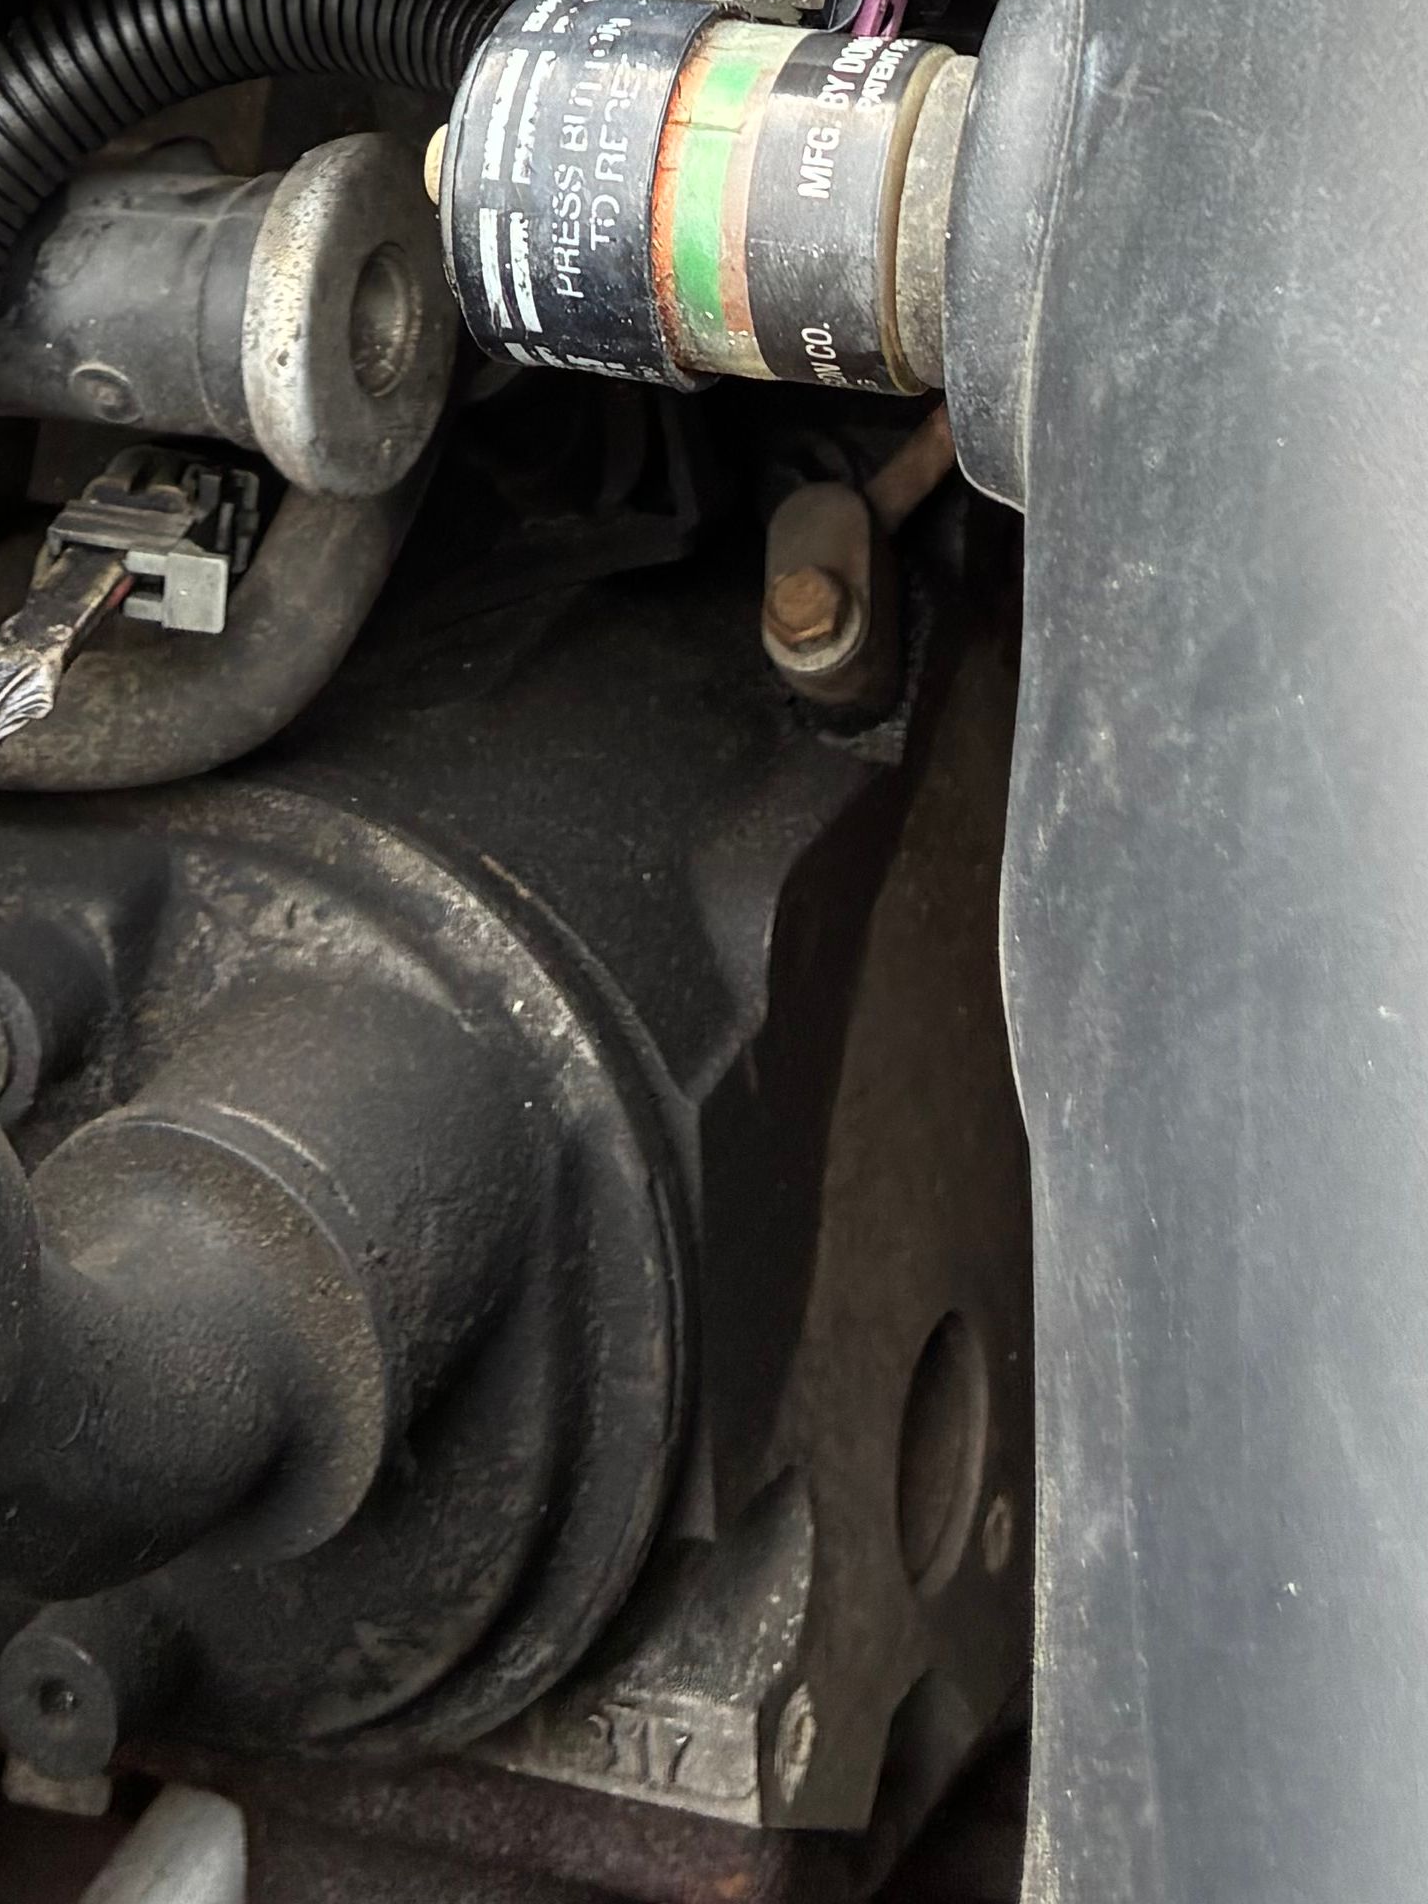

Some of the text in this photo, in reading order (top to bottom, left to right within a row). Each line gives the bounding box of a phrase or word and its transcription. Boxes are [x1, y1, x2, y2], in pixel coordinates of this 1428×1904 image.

[818, 74, 855, 110] BY
[797, 120, 842, 199] MFG.
[552, 163, 584, 299] PRESS
[590, 194, 620, 250] TO
[801, 322, 836, 359] CO.
